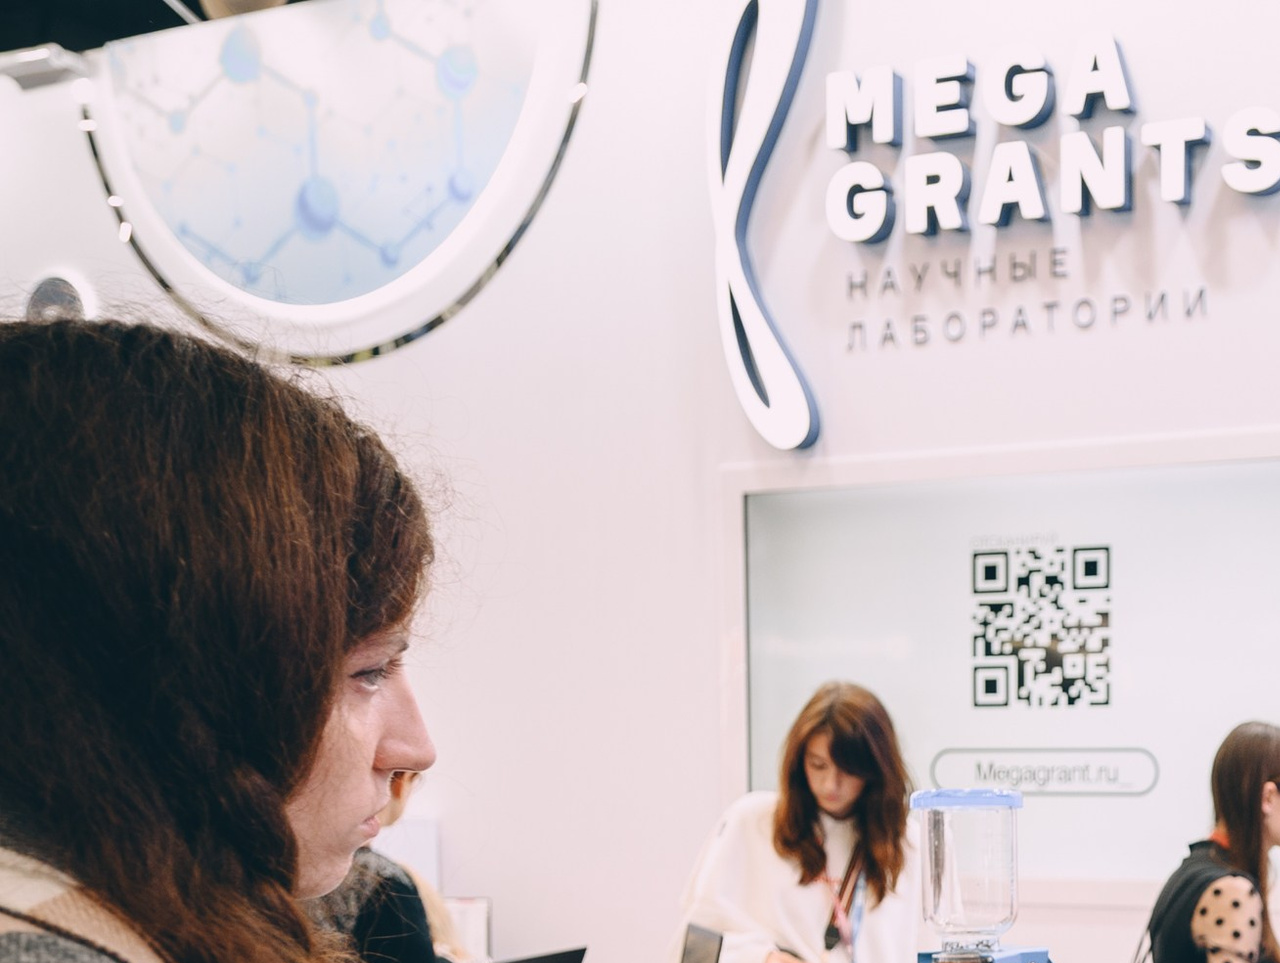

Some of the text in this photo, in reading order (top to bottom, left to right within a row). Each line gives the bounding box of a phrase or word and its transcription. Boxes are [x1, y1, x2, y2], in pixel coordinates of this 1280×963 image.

[825, 34, 1137, 152] MEGA
[846, 247, 1069, 300] НАУЧНЫЕ
[845, 287, 1209, 352] ЛАБОРАТОРИИ
